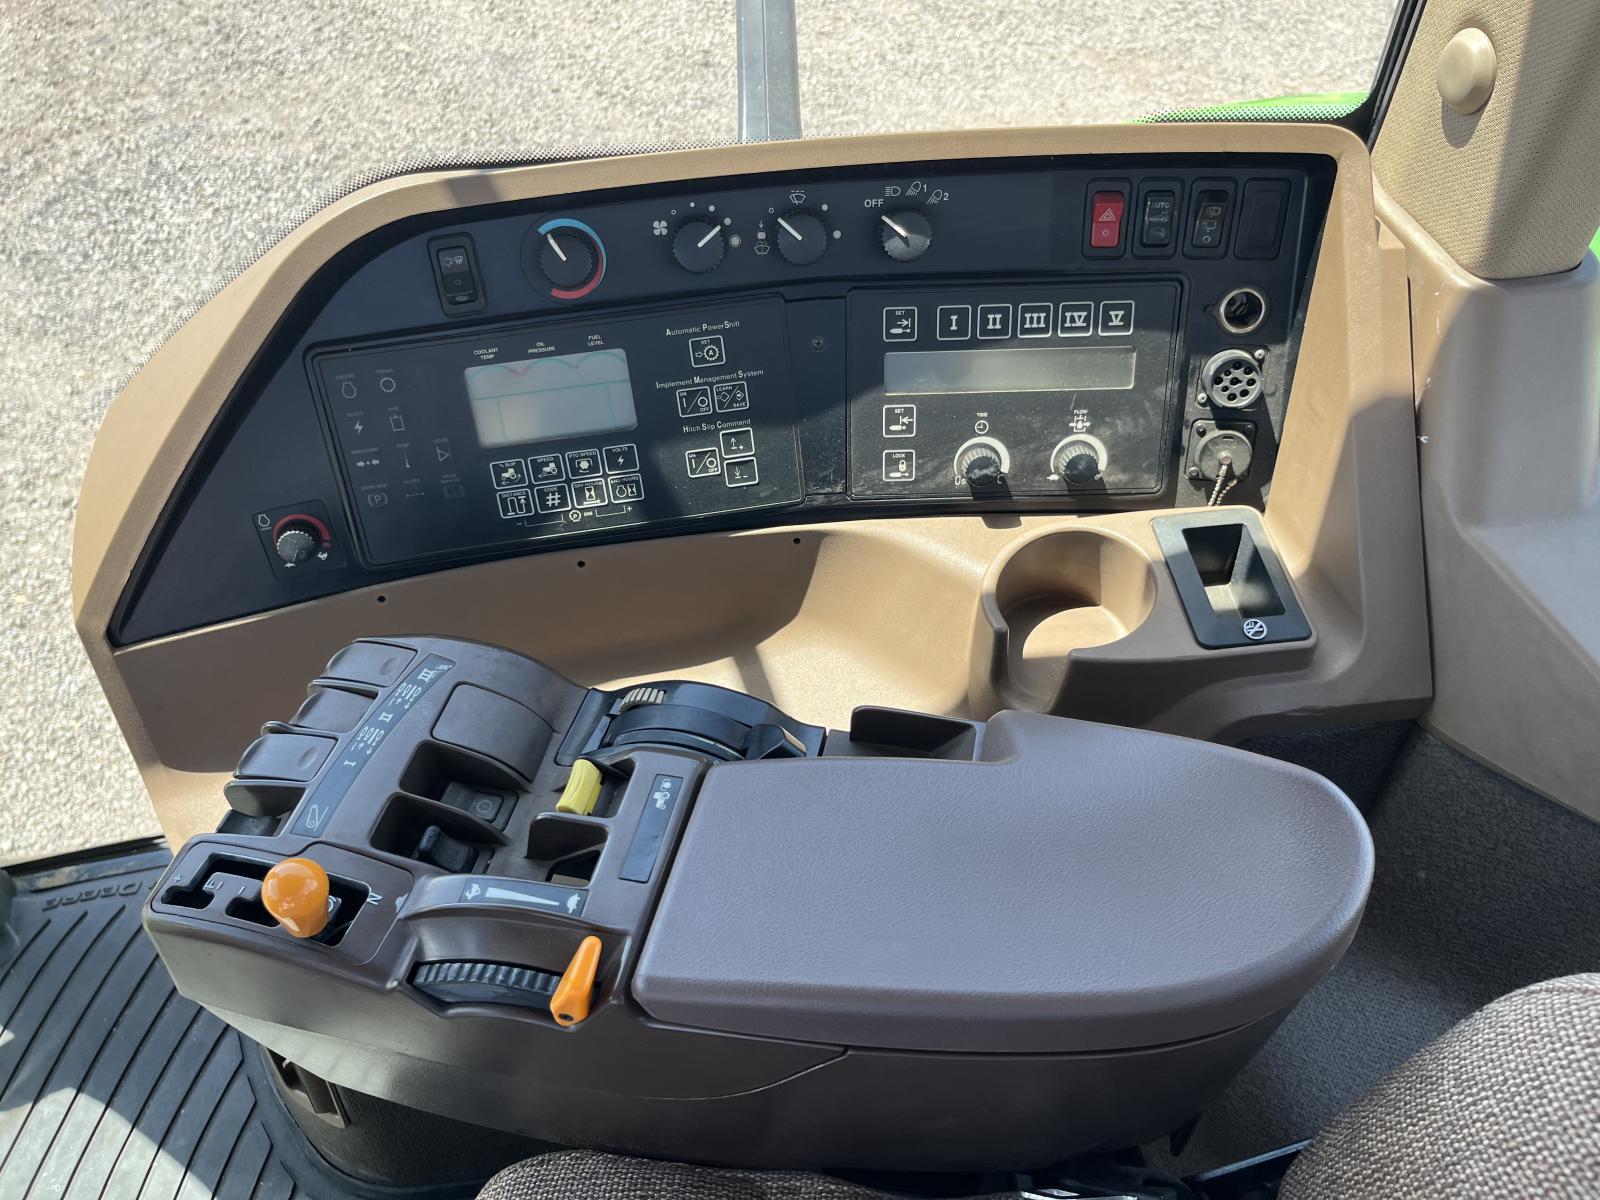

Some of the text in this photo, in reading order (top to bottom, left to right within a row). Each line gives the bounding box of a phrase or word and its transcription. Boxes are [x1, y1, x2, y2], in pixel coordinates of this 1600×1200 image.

[922, 184, 928, 193] 1
[863, 198, 884, 208] OFF
[943, 193, 949, 202] 2
[987, 314, 1002, 330] II
[1024, 312, 1047, 329] III
[1064, 311, 1088, 327] IV
[1108, 310, 1125, 327] V
[666, 321, 740, 337] Automatic PowerShift
[473, 347, 499, 356] COOLANT
[528, 346, 556, 354] PRESSURE
[656, 369, 764, 389] Implement Management System
[683, 419, 751, 433] Hitch Slip Command
[42, 882, 143, 912] DEERE
[367, 893, 384, 905] N
